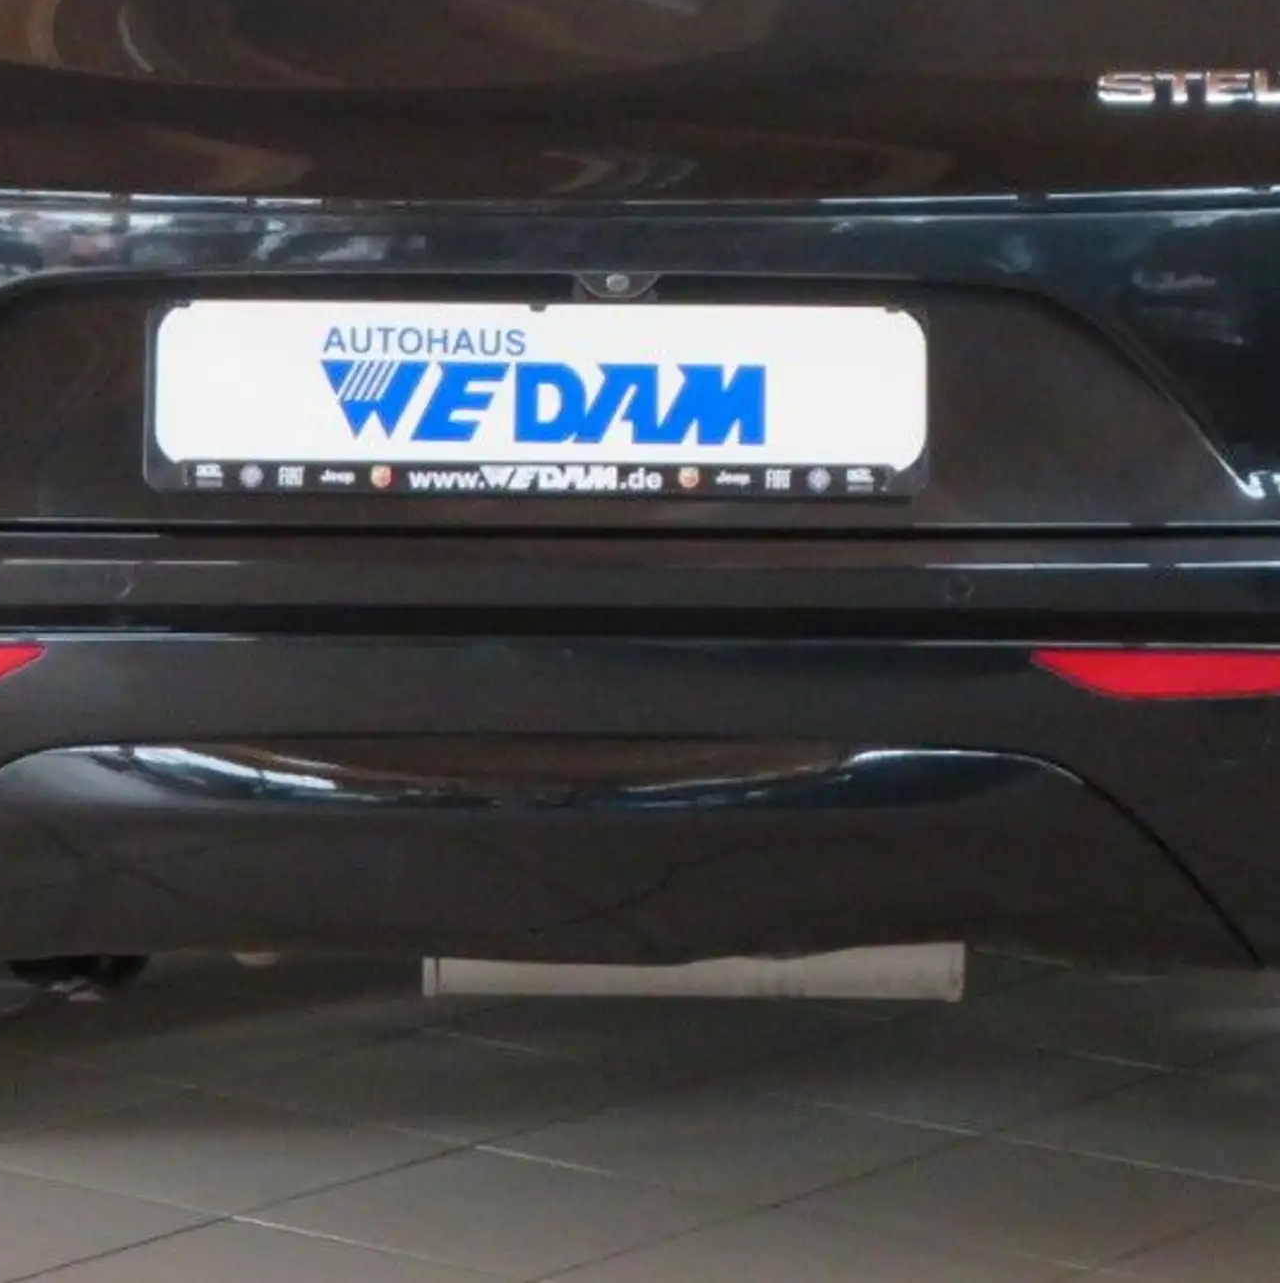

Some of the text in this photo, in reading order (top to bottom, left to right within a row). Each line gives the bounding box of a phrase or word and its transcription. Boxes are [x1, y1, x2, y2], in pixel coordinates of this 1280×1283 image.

[322, 327, 526, 355] AUTOHAUS
[320, 360, 767, 446] WEDAM
[408, 465, 663, 490] www.WEDAM.de
